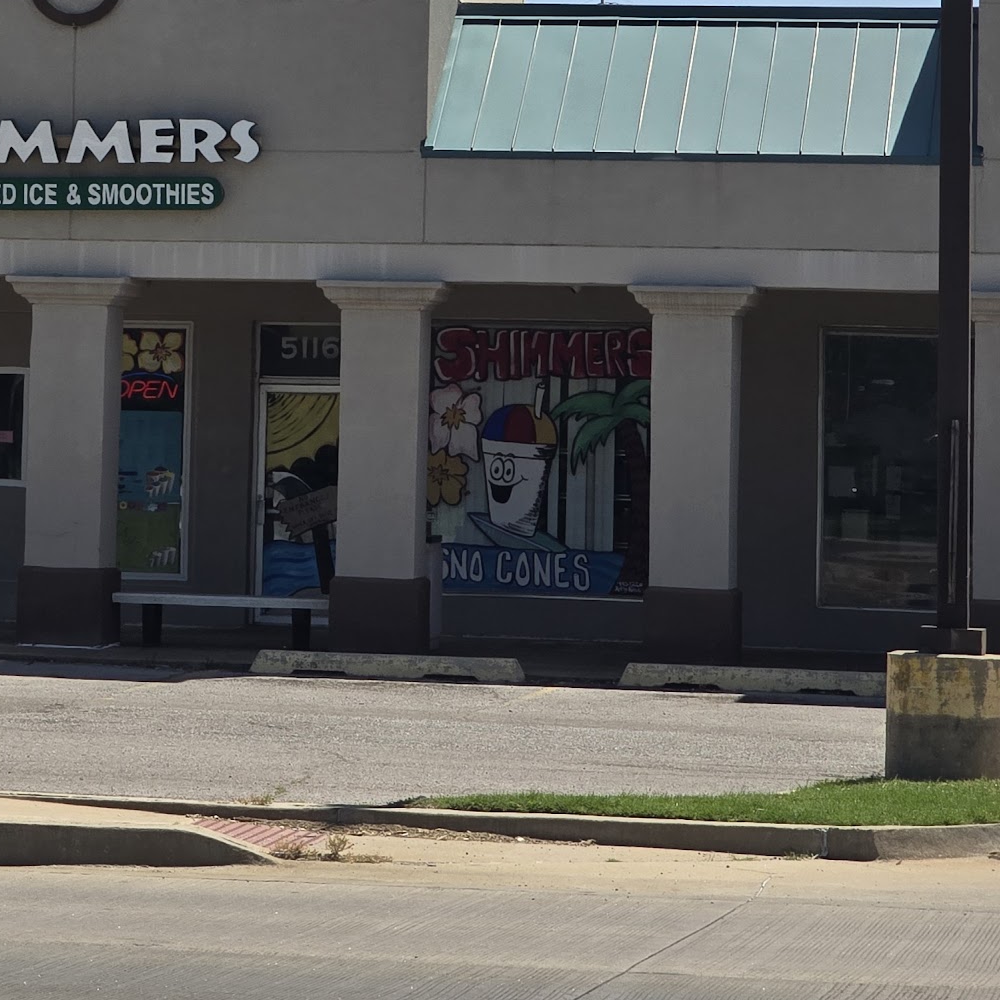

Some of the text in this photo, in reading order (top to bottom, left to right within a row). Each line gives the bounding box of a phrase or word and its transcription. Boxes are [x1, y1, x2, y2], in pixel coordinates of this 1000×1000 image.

[23, 182, 58, 205] ICE
[66, 182, 82, 206] &
[87, 182, 215, 206] SMOOTHIES
[281, 336, 340, 360] 5116
[434, 327, 652, 382] SHIMMERS
[496, 551, 591, 592] CONES
